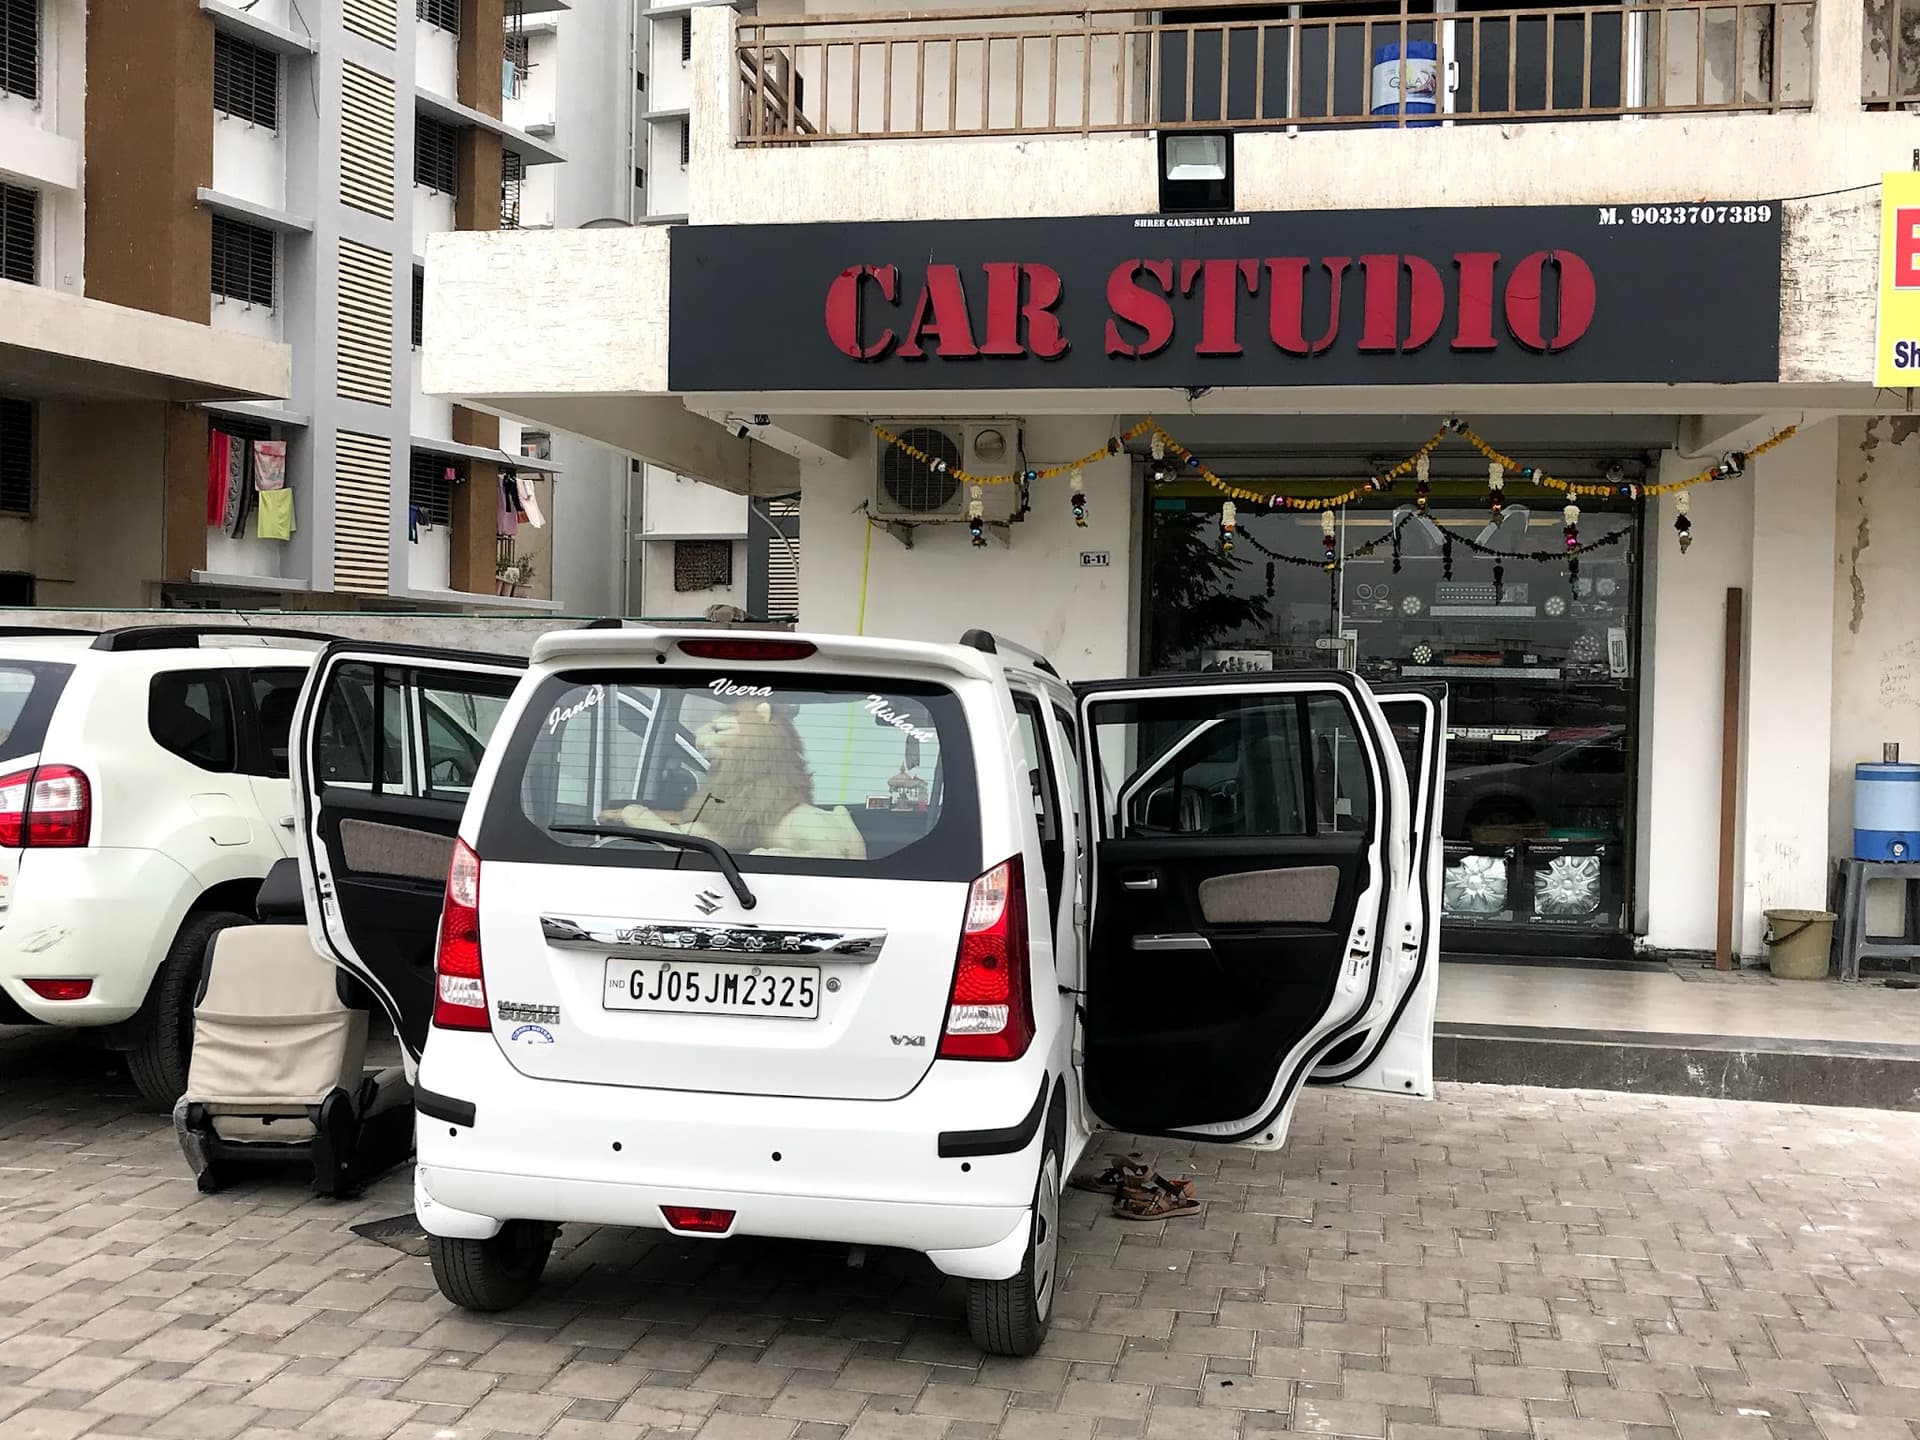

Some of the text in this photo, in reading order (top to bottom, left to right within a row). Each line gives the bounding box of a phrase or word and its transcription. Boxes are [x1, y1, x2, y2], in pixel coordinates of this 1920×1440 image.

[1134, 216, 1250, 227] SHREE GANESHAY NAMAH
[1599, 205, 1772, 225] M. 9033707389
[825, 249, 1597, 361] CAR STUDIO
[1083, 554, 1107, 565] G-11
[709, 677, 774, 697] Veera
[864, 694, 934, 742] Nishant
[609, 979, 625, 989] IND
[629, 969, 814, 1007] GJ05JM2325
[498, 1000, 560, 1013] MARUTI
[498, 1010, 560, 1024] SUZUKI
[890, 1034, 926, 1046] VXI
